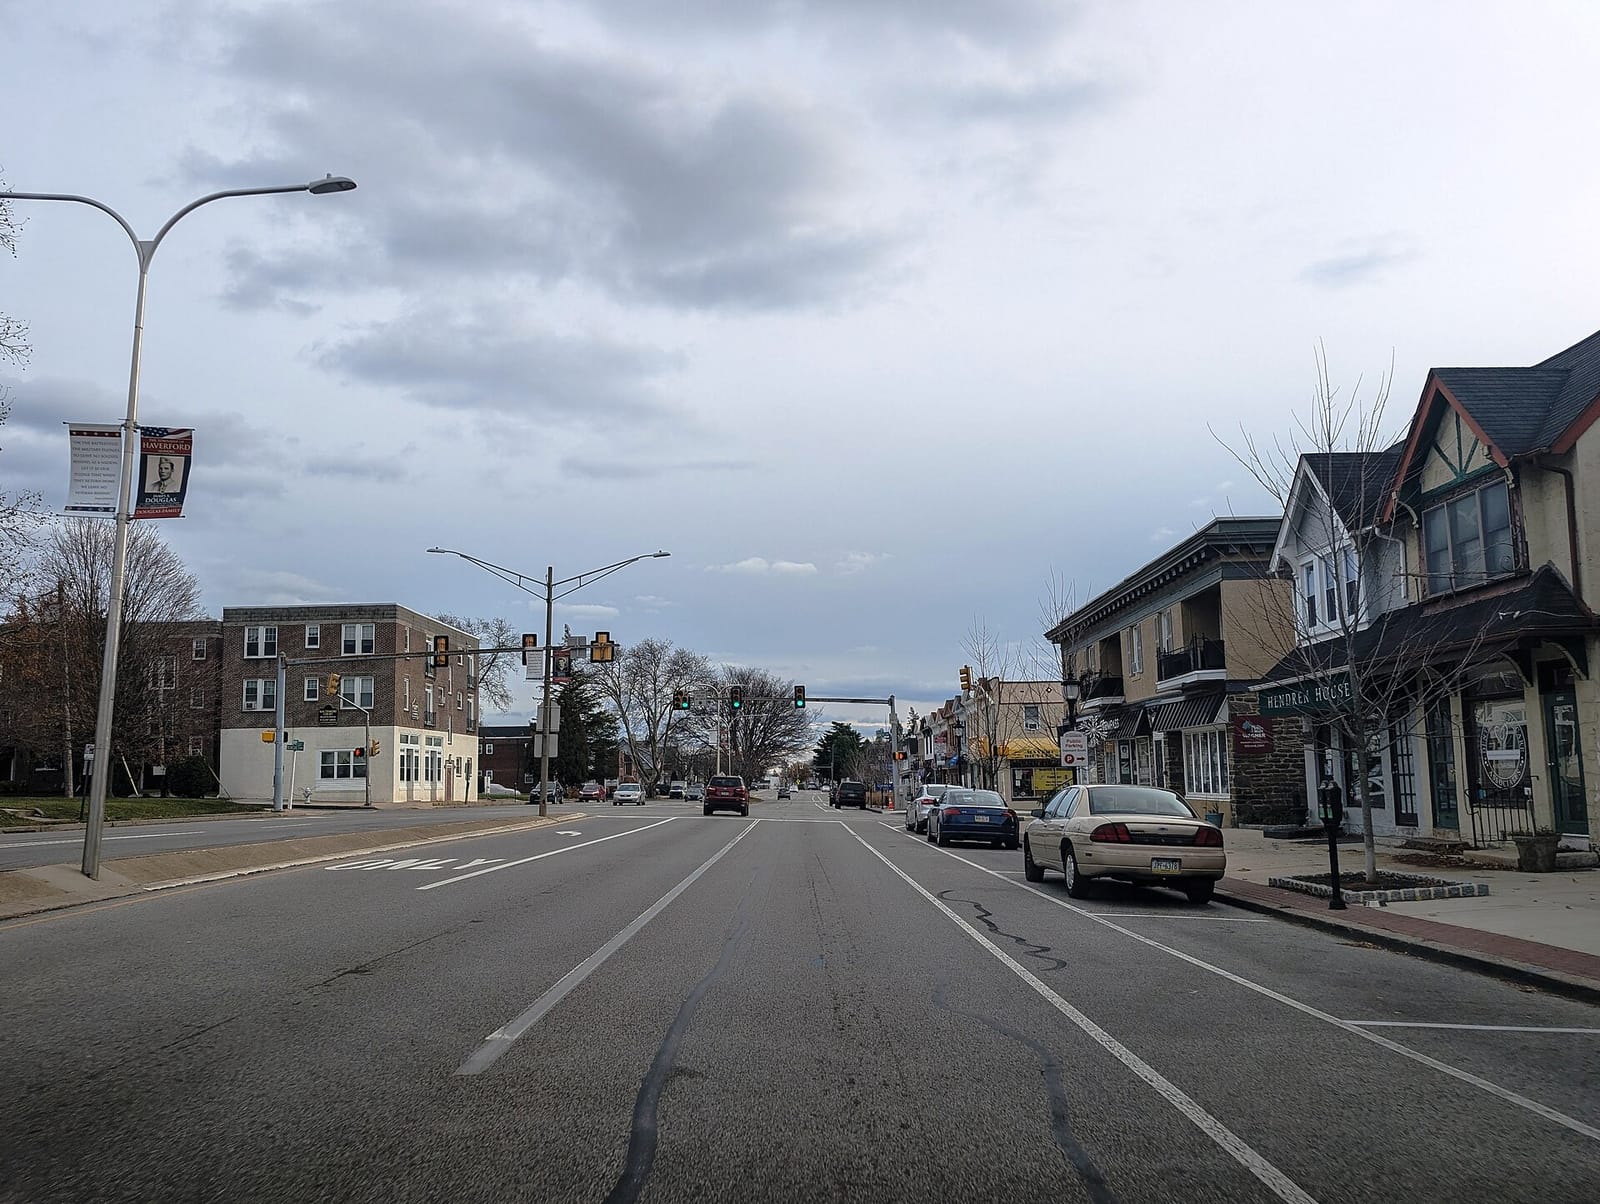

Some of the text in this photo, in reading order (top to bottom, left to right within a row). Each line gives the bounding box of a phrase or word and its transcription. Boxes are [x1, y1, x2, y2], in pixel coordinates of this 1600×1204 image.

[142, 442, 191, 451] HAVERFORD
[1267, 683, 1350, 708] HENDREN HOUSE
[324, 858, 507, 871] ONLY
